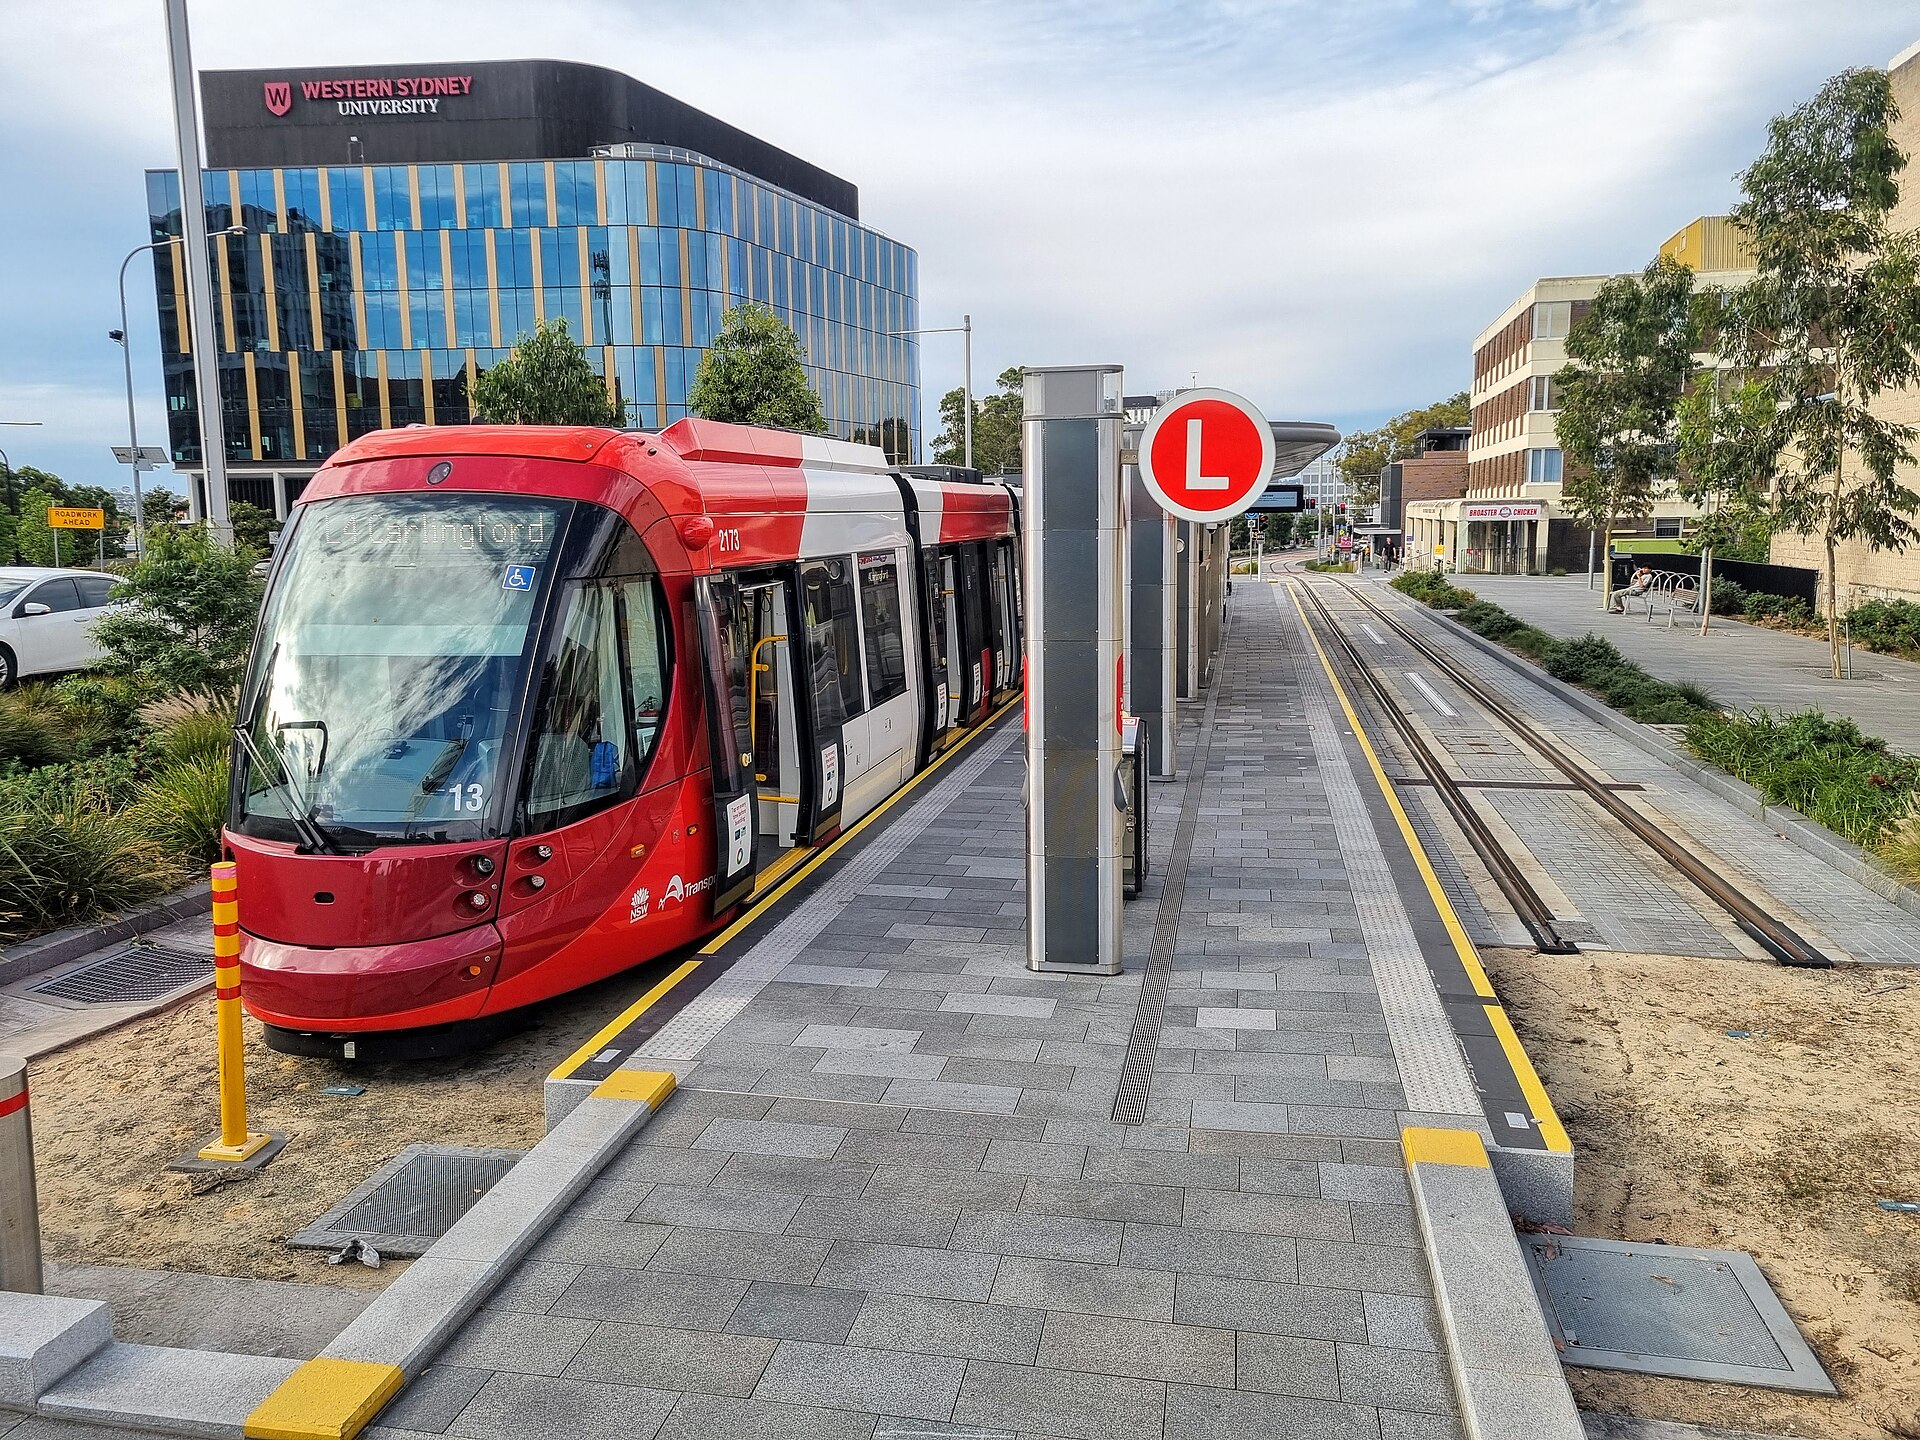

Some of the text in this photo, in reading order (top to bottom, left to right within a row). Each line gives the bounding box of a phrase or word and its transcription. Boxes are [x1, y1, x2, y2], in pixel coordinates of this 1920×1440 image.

[266, 87, 288, 107] W
[301, 76, 472, 100] WESTERN SYDNEY
[337, 98, 439, 115] UNIVERSITY
[1185, 419, 1230, 490] L
[54, 510, 98, 518] ROADWORK
[1469, 509, 1498, 517] BROASTER
[369, 512, 544, 550] Carlingford
[718, 528, 740, 551] 2173
[448, 783, 483, 812] 13
[630, 903, 649, 920] NSW
